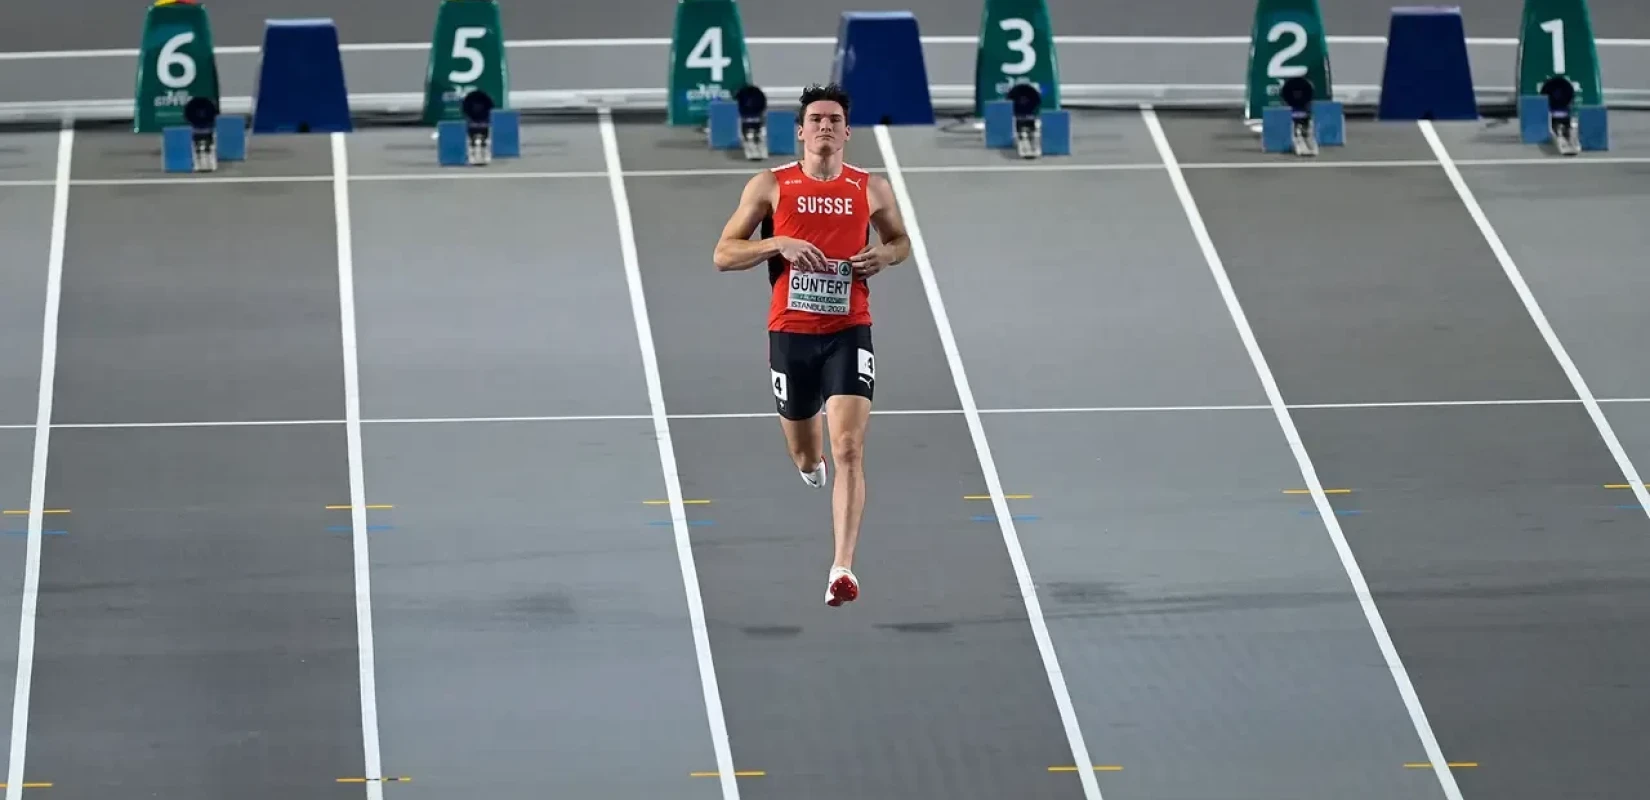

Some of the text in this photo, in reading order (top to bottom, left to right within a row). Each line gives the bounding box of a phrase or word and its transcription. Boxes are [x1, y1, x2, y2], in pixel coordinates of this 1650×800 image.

[157, 32, 196, 88] 6
[449, 27, 487, 83] 5
[686, 27, 732, 82] 4
[1000, 18, 1036, 75] 3
[1267, 22, 1308, 78] 2
[1540, 19, 1566, 74] 1
[797, 195, 853, 215] SUISSE
[791, 274, 851, 295] GÜNTERT
[774, 376, 783, 396] 4
[867, 356, 874, 374] 4
